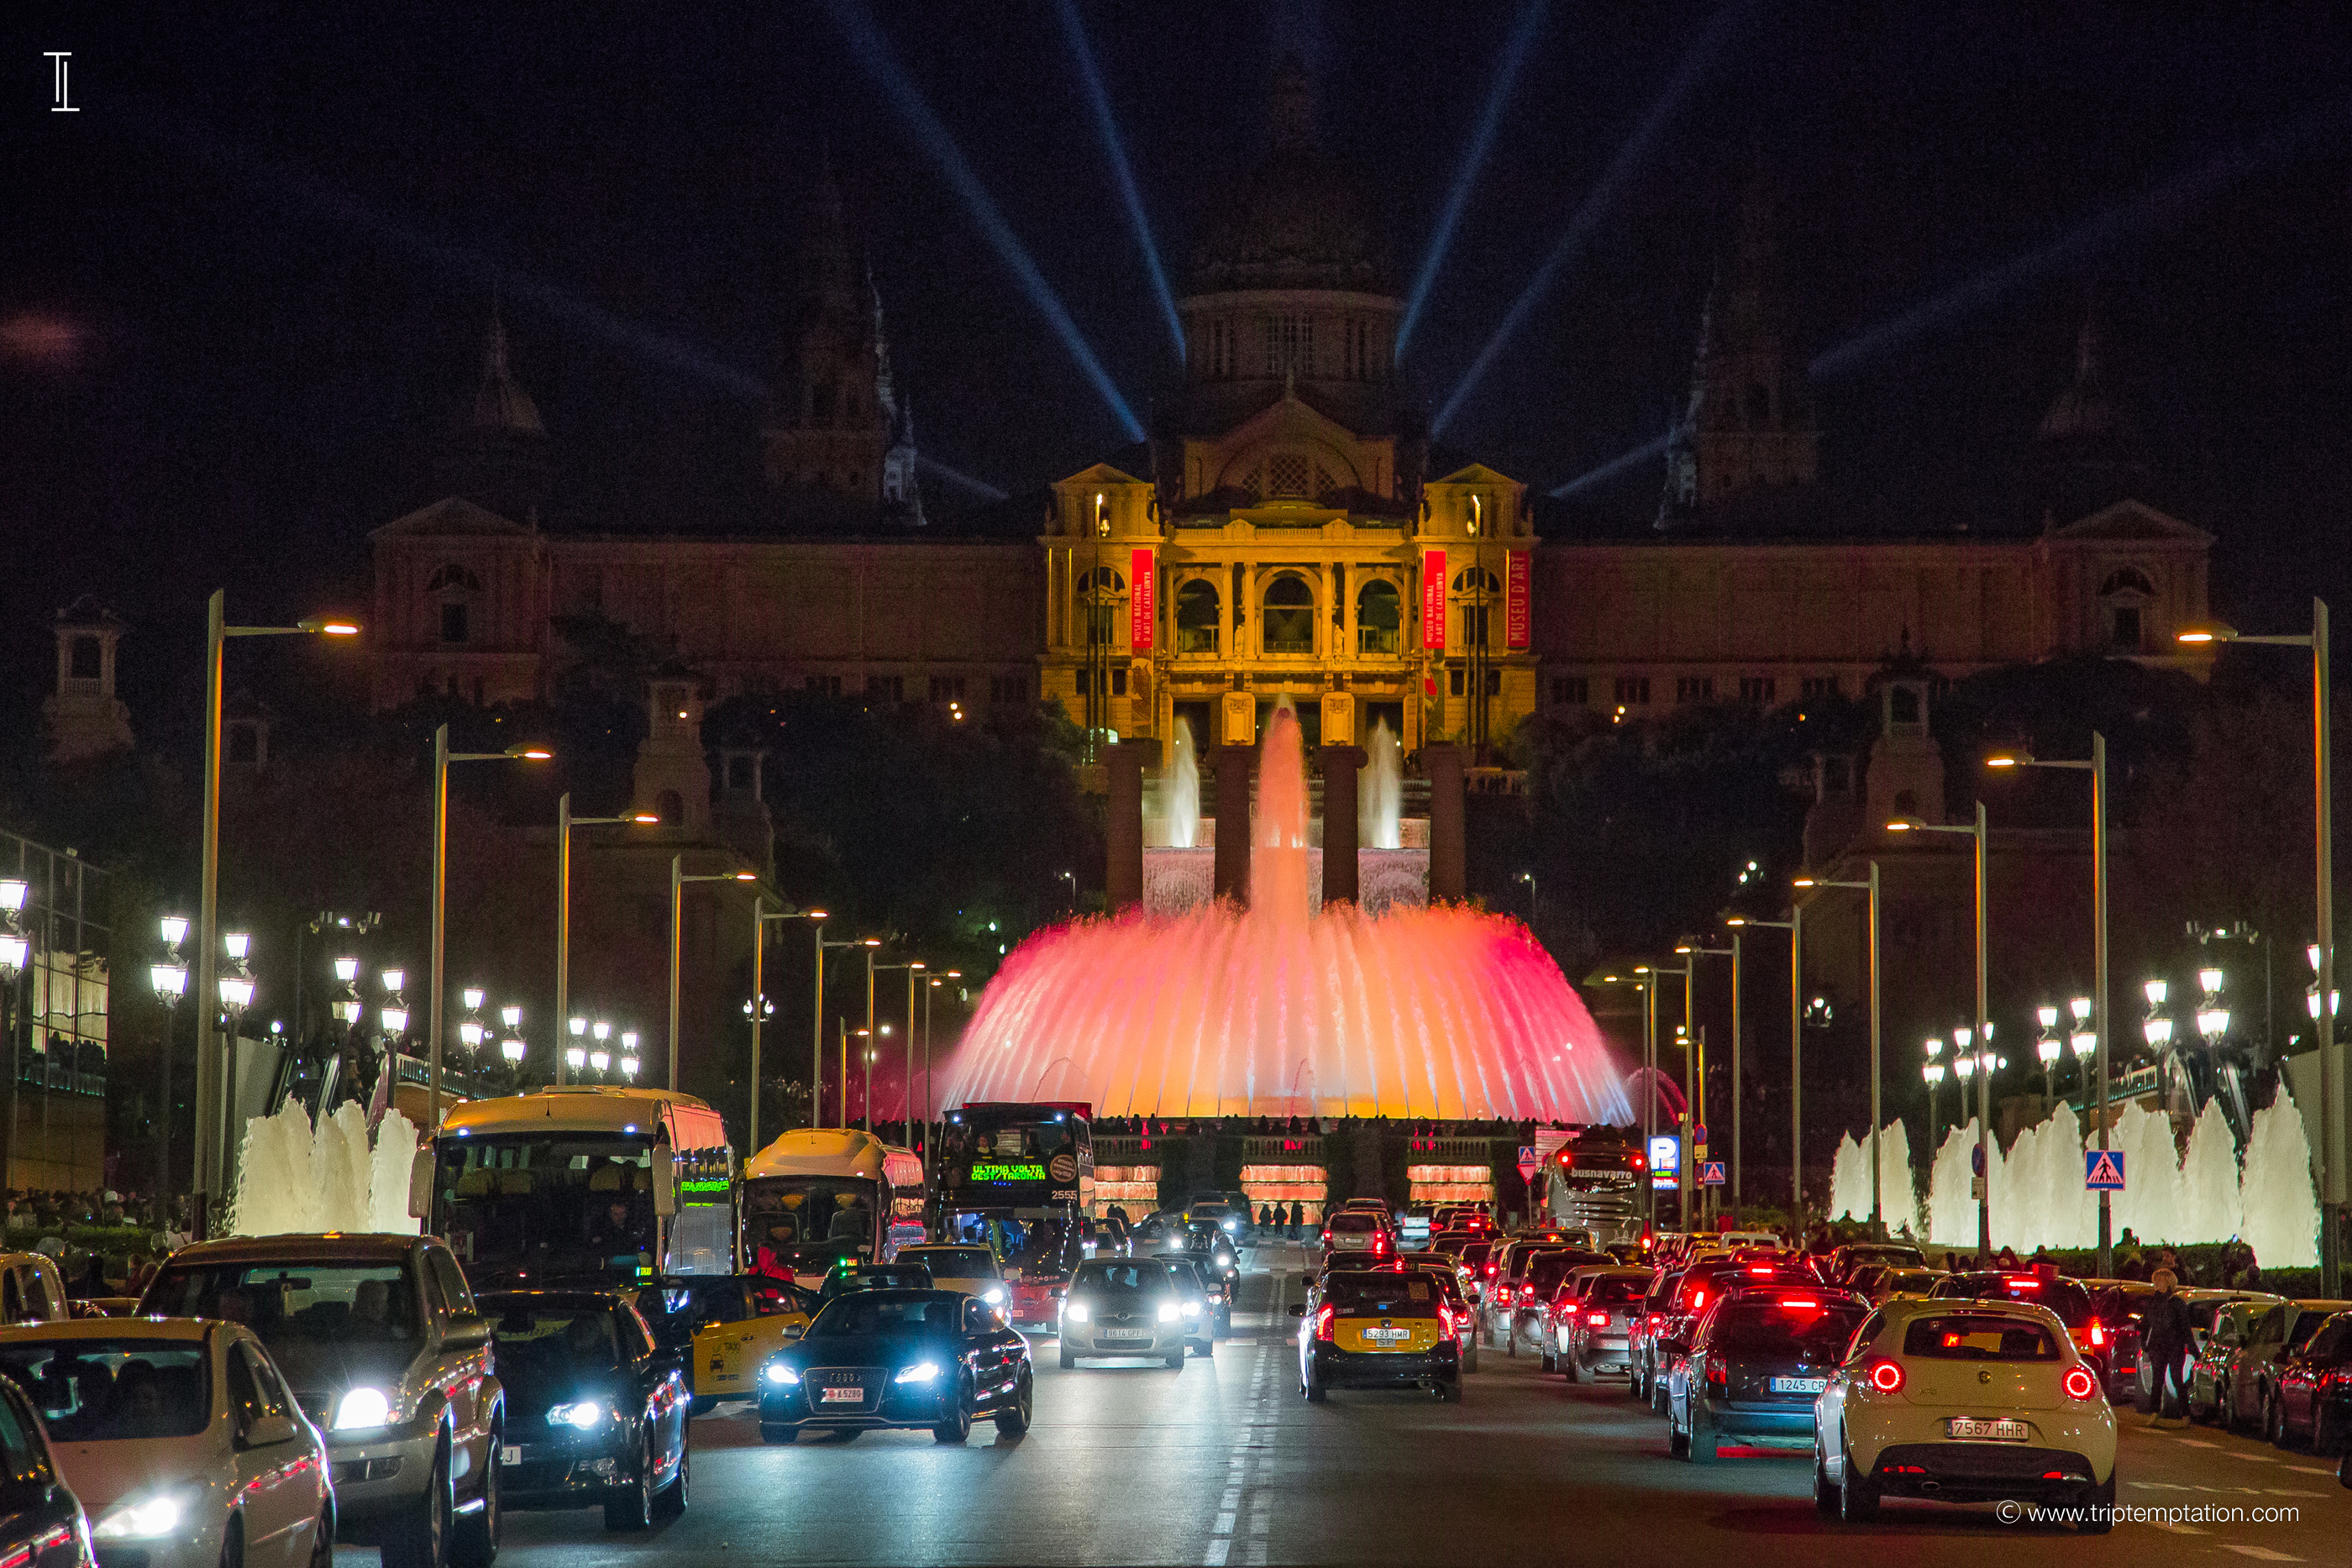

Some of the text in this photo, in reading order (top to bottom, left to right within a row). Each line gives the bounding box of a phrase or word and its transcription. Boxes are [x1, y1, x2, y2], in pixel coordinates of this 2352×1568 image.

[1510, 555, 1525, 641] MUSEU D'ART
[1143, 611, 1151, 620] DE
[1651, 1137, 1677, 1170] P
[973, 1165, 1043, 1173] ULTIMA VOLTA
[1571, 1167, 1633, 1179] busnavarro
[1052, 1190, 1078, 1200] 2555
[1396, 1261, 1402, 1270] 2
[640, 1266, 653, 1276] TAXI
[1368, 1329, 1408, 1339] 5293 HMR
[1780, 1379, 1807, 1391] 1245
[1955, 1422, 2024, 1437] 7567 HHR
